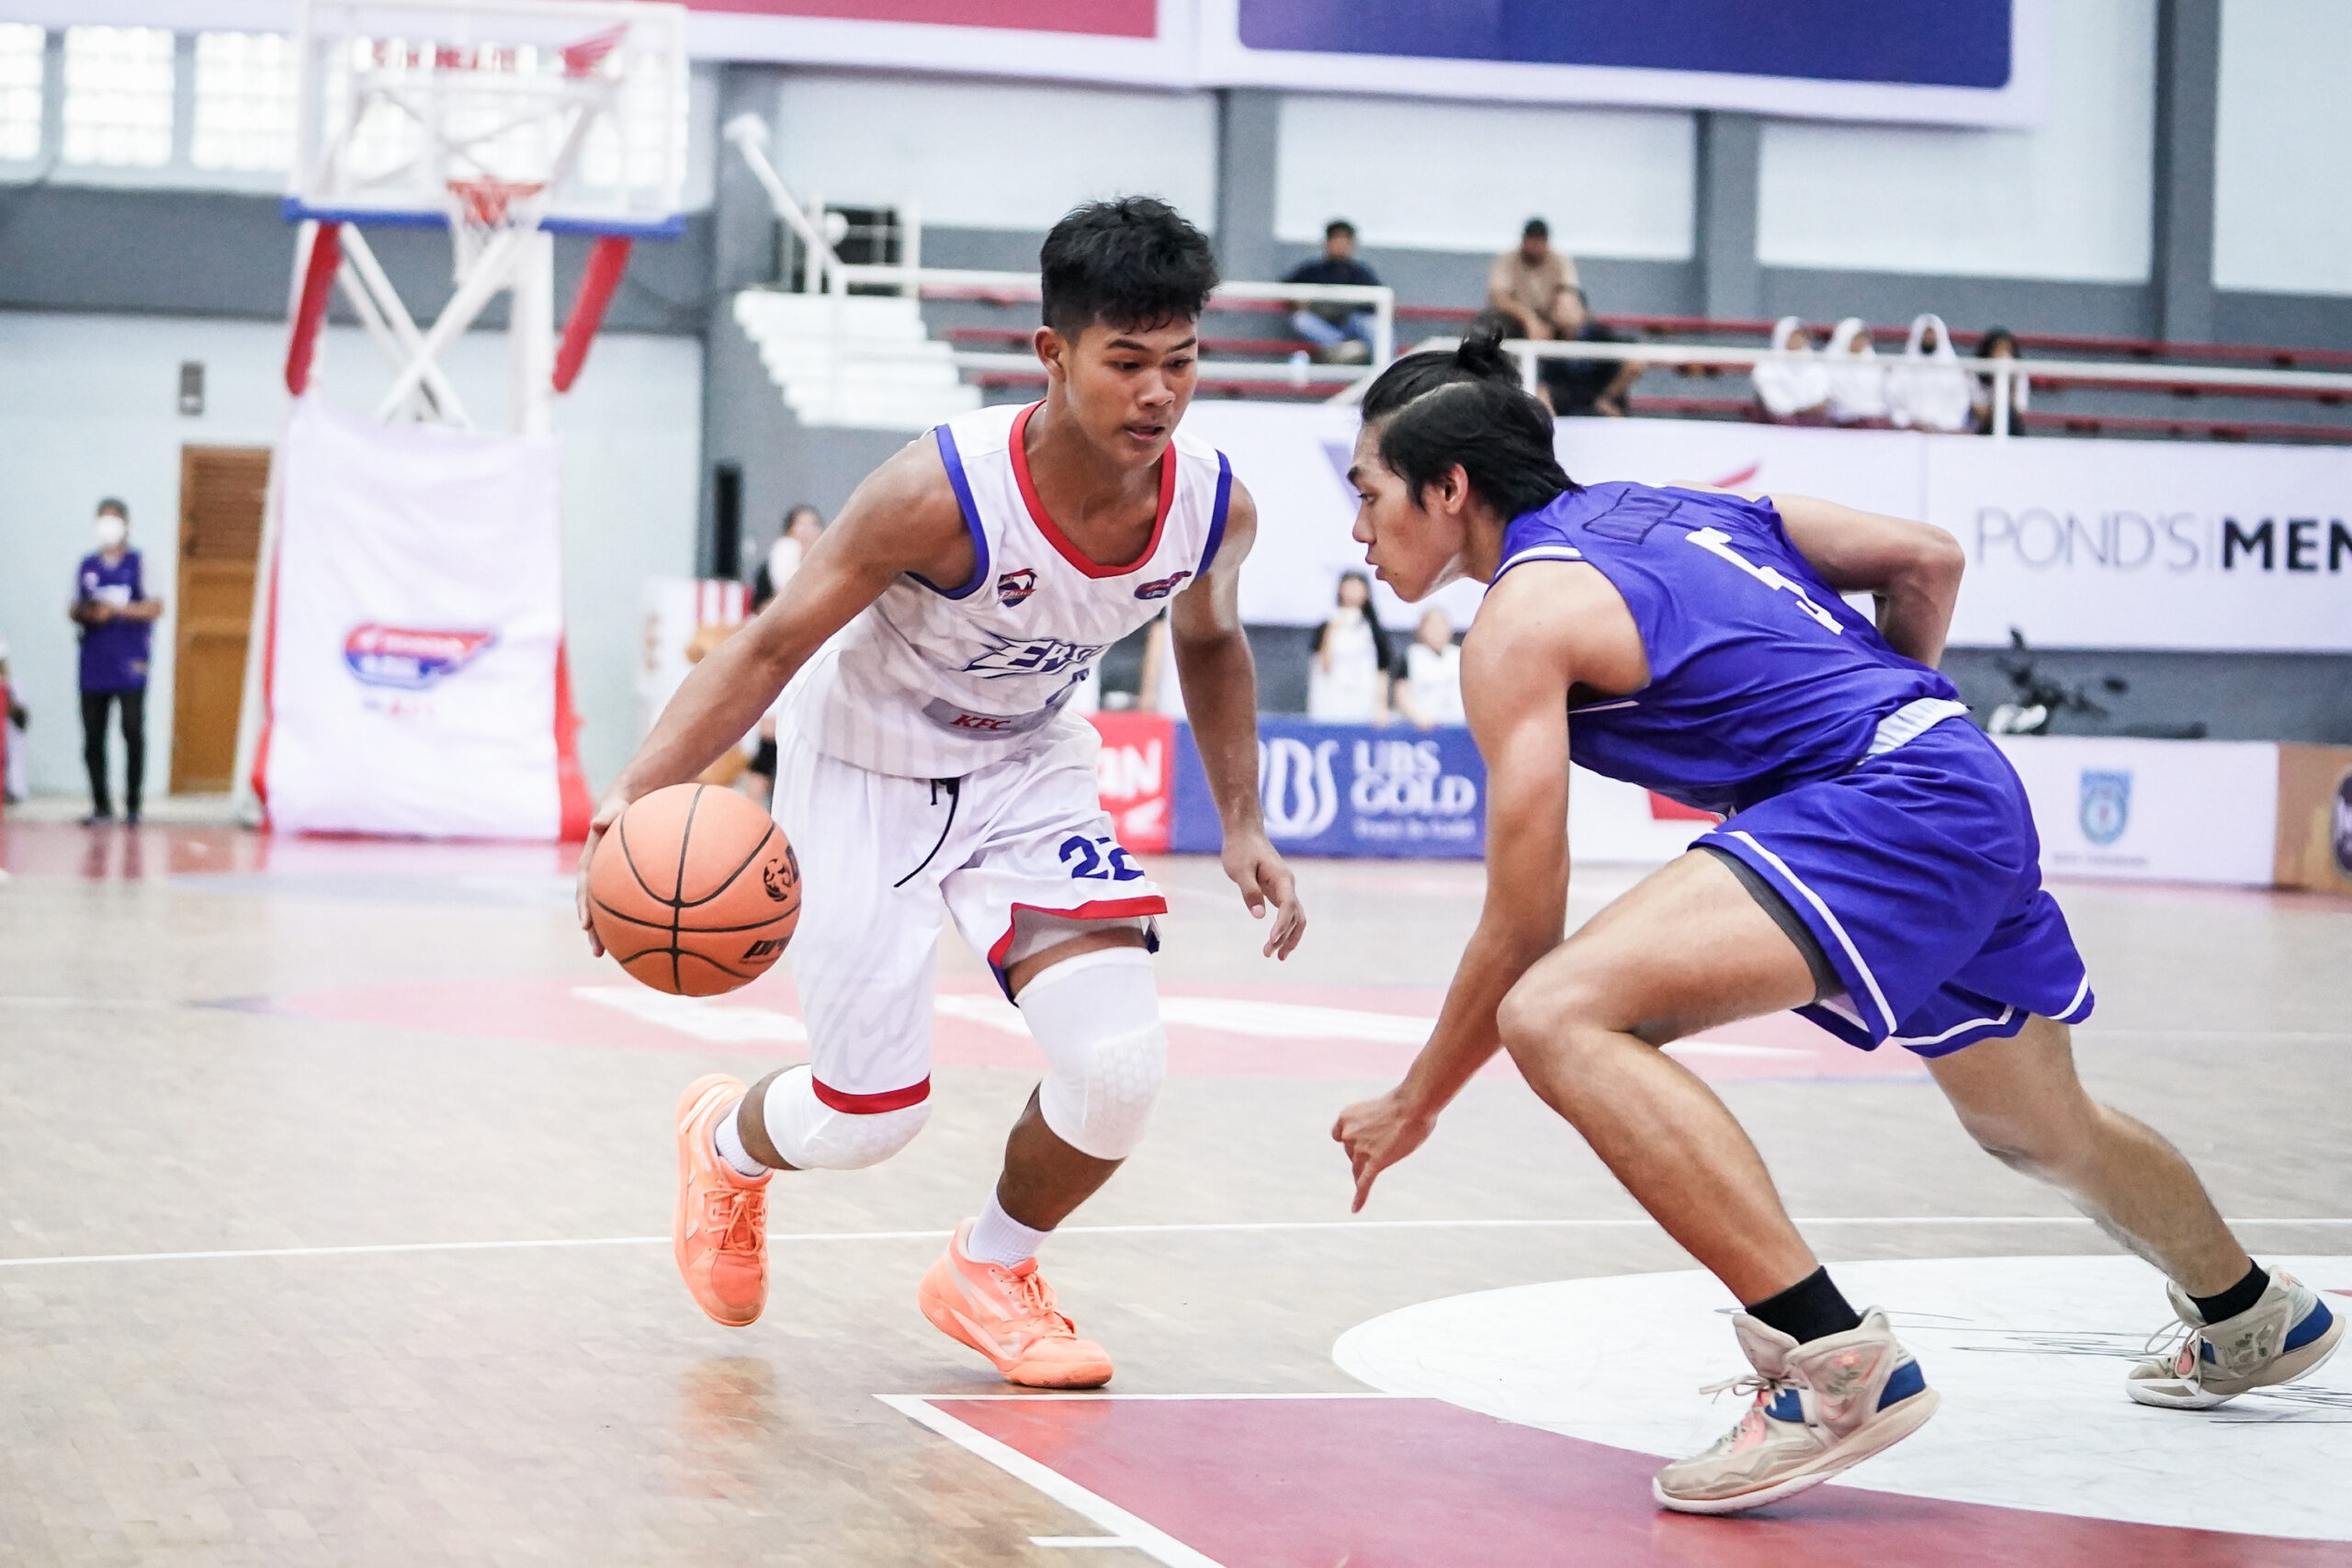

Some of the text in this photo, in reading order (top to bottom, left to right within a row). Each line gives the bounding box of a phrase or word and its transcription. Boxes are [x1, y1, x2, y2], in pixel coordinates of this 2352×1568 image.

[1976, 506, 2200, 573] POND'S
[952, 714, 1012, 731] KFC
[1352, 739, 1443, 779] UBS
[1349, 773, 1478, 817] GOLD
[1058, 835, 1146, 882] 22
